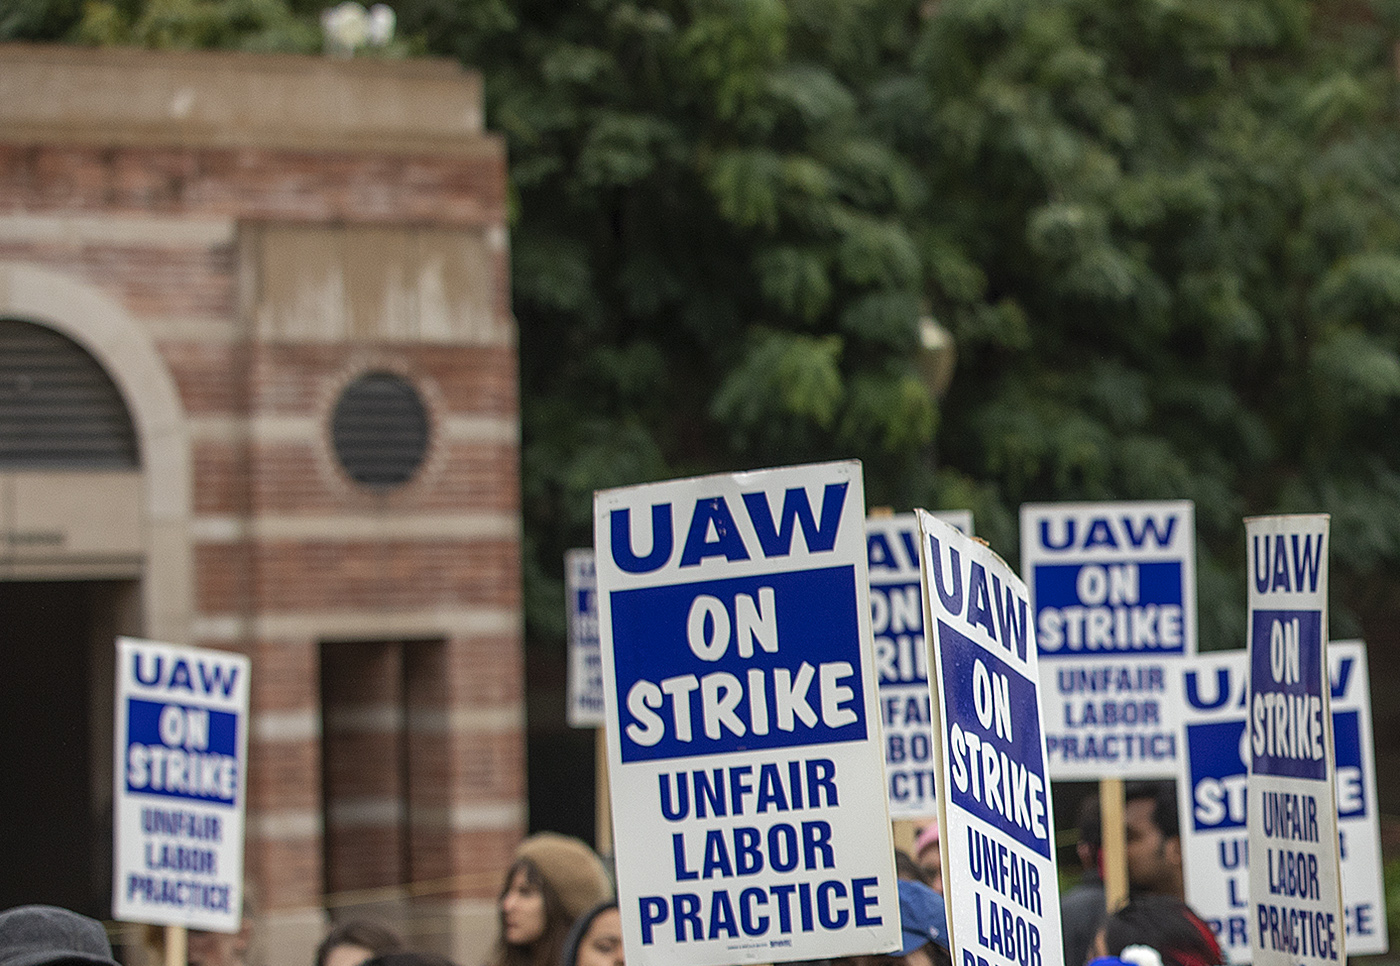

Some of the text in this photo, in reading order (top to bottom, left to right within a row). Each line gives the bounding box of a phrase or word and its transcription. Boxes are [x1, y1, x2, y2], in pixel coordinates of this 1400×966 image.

[610, 481, 850, 574] UAW
[1038, 515, 1176, 551] UAW
[1076, 564, 1140, 605] ON
[1254, 534, 1323, 595] UAW
[687, 587, 779, 661] ON
[929, 534, 1028, 664] UAW
[1037, 604, 1182, 652] STRIKE
[133, 654, 238, 697] UAW
[1058, 666, 1163, 695] UNFAIR
[1269, 618, 1300, 686] ON
[159, 705, 210, 750] ON
[626, 661, 858, 747] STRIKE
[973, 658, 1012, 743] ON
[1064, 699, 1160, 728] LABOR
[1252, 692, 1324, 761] STRIKE
[128, 742, 237, 799] STRIKE
[658, 758, 839, 822] UNFAIR
[951, 722, 1048, 840] STRIKE
[141, 808, 222, 842] UNFAIR
[1262, 791, 1319, 844] UNFAIR
[145, 842, 216, 875] LABOR
[672, 821, 835, 881] LABOR
[967, 825, 1042, 918] UNFAIR
[1267, 848, 1320, 900] LABOR
[127, 872, 231, 913] PRACTICE
[639, 877, 883, 945] PRACTICE
[1257, 903, 1338, 961] PRACTICE
